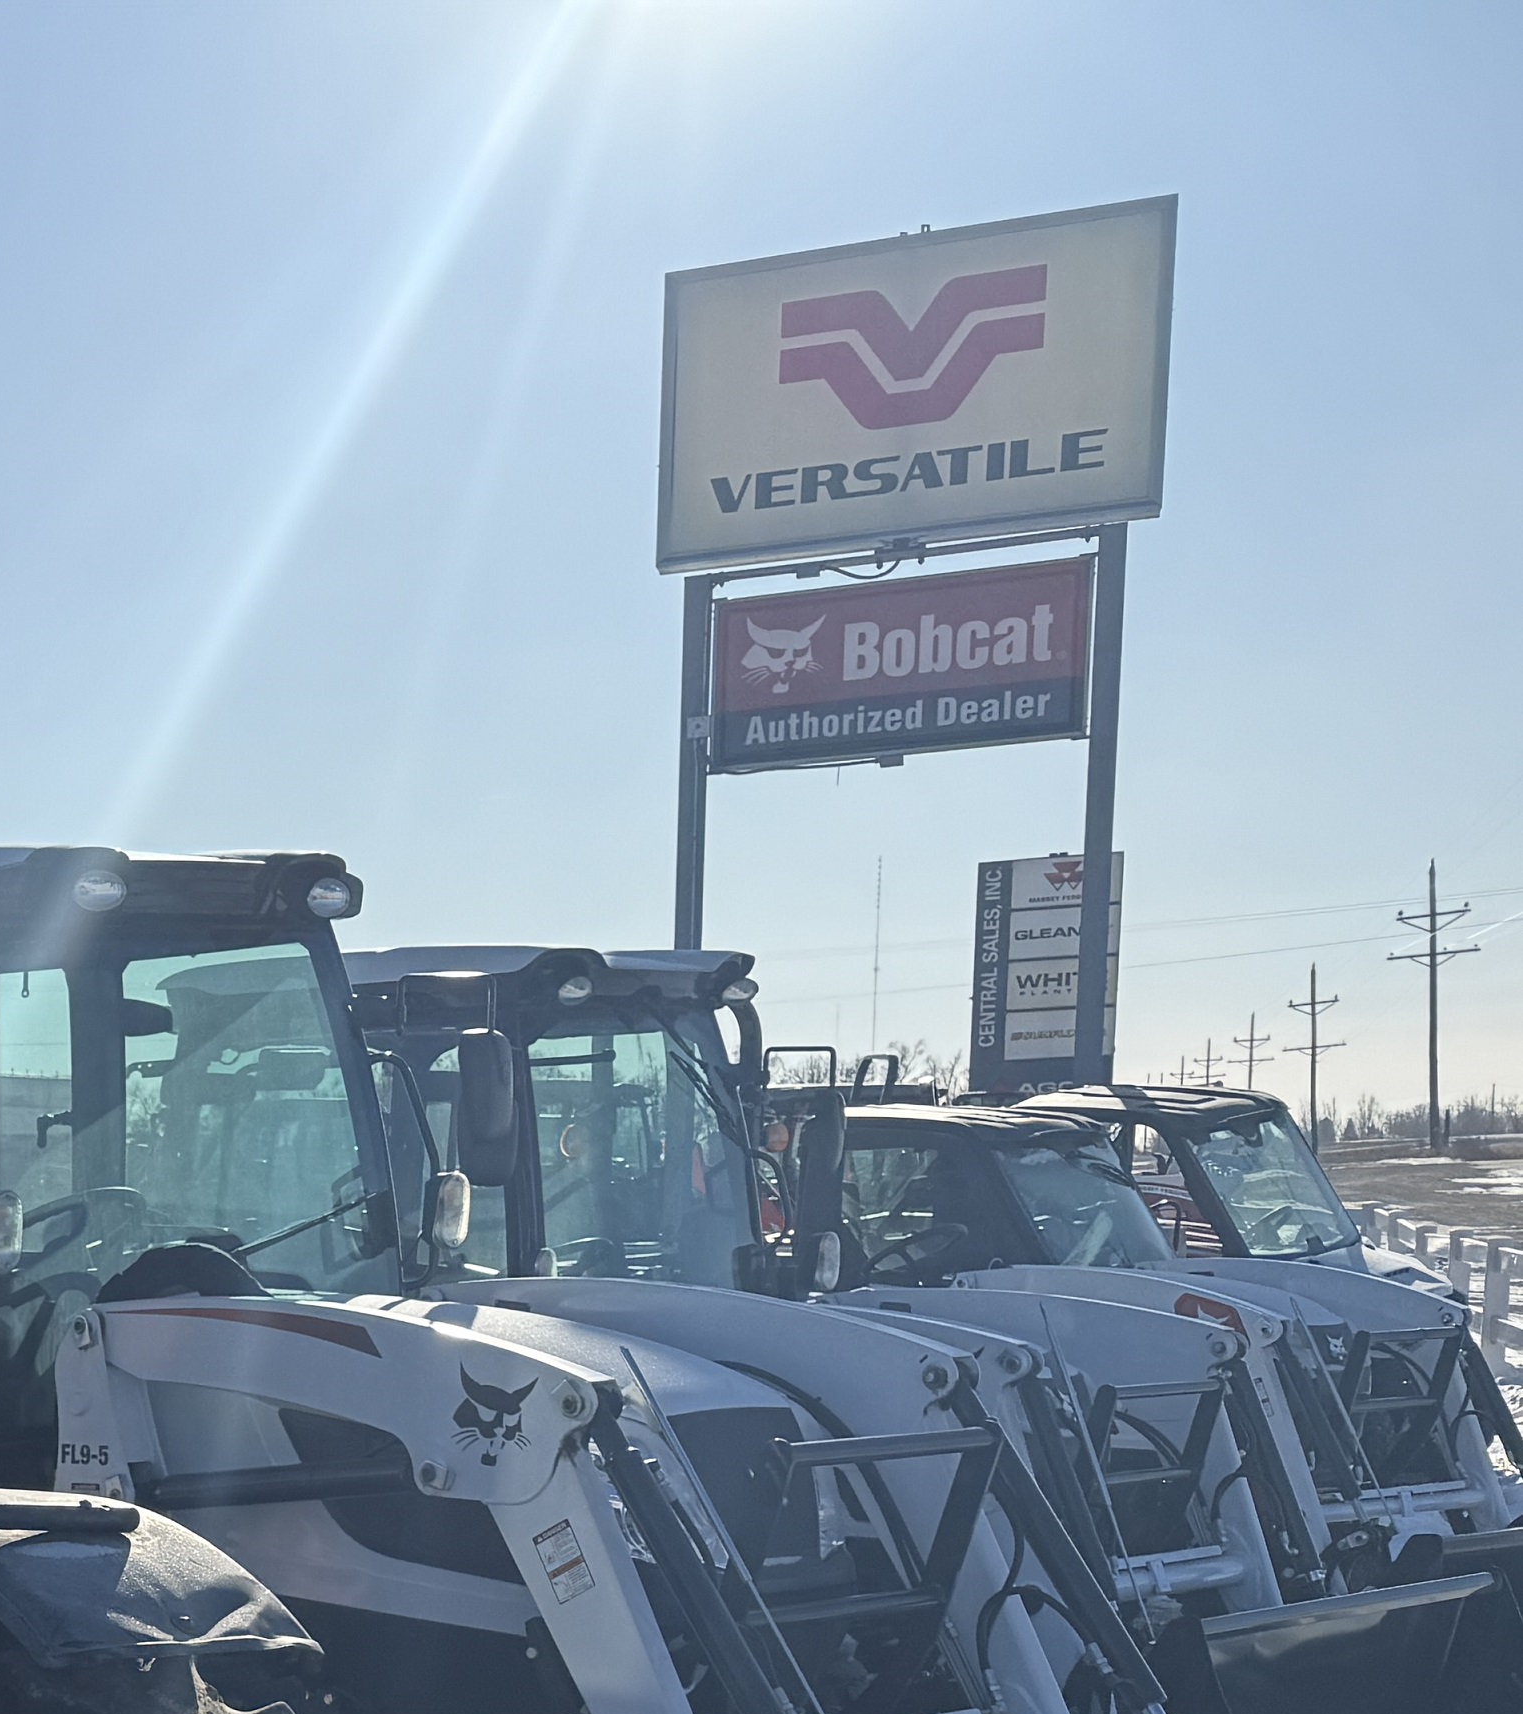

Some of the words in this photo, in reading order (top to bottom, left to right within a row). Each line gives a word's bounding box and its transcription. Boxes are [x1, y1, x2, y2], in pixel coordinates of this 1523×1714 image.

[710, 428, 1109, 513] VERSATILE
[843, 604, 1053, 681] Bobcat
[745, 700, 923, 745] Authorized
[937, 690, 1051, 726] Dealer
[984, 866, 1002, 901] INC.
[981, 904, 1002, 962] SALES,
[1015, 927, 1080, 940] GLEAN
[1016, 972, 1077, 989] WHI
[1020, 988, 1072, 996] PLANT
[978, 967, 998, 1047] CENTRAL
[61, 1444, 109, 1466] FL9-5
